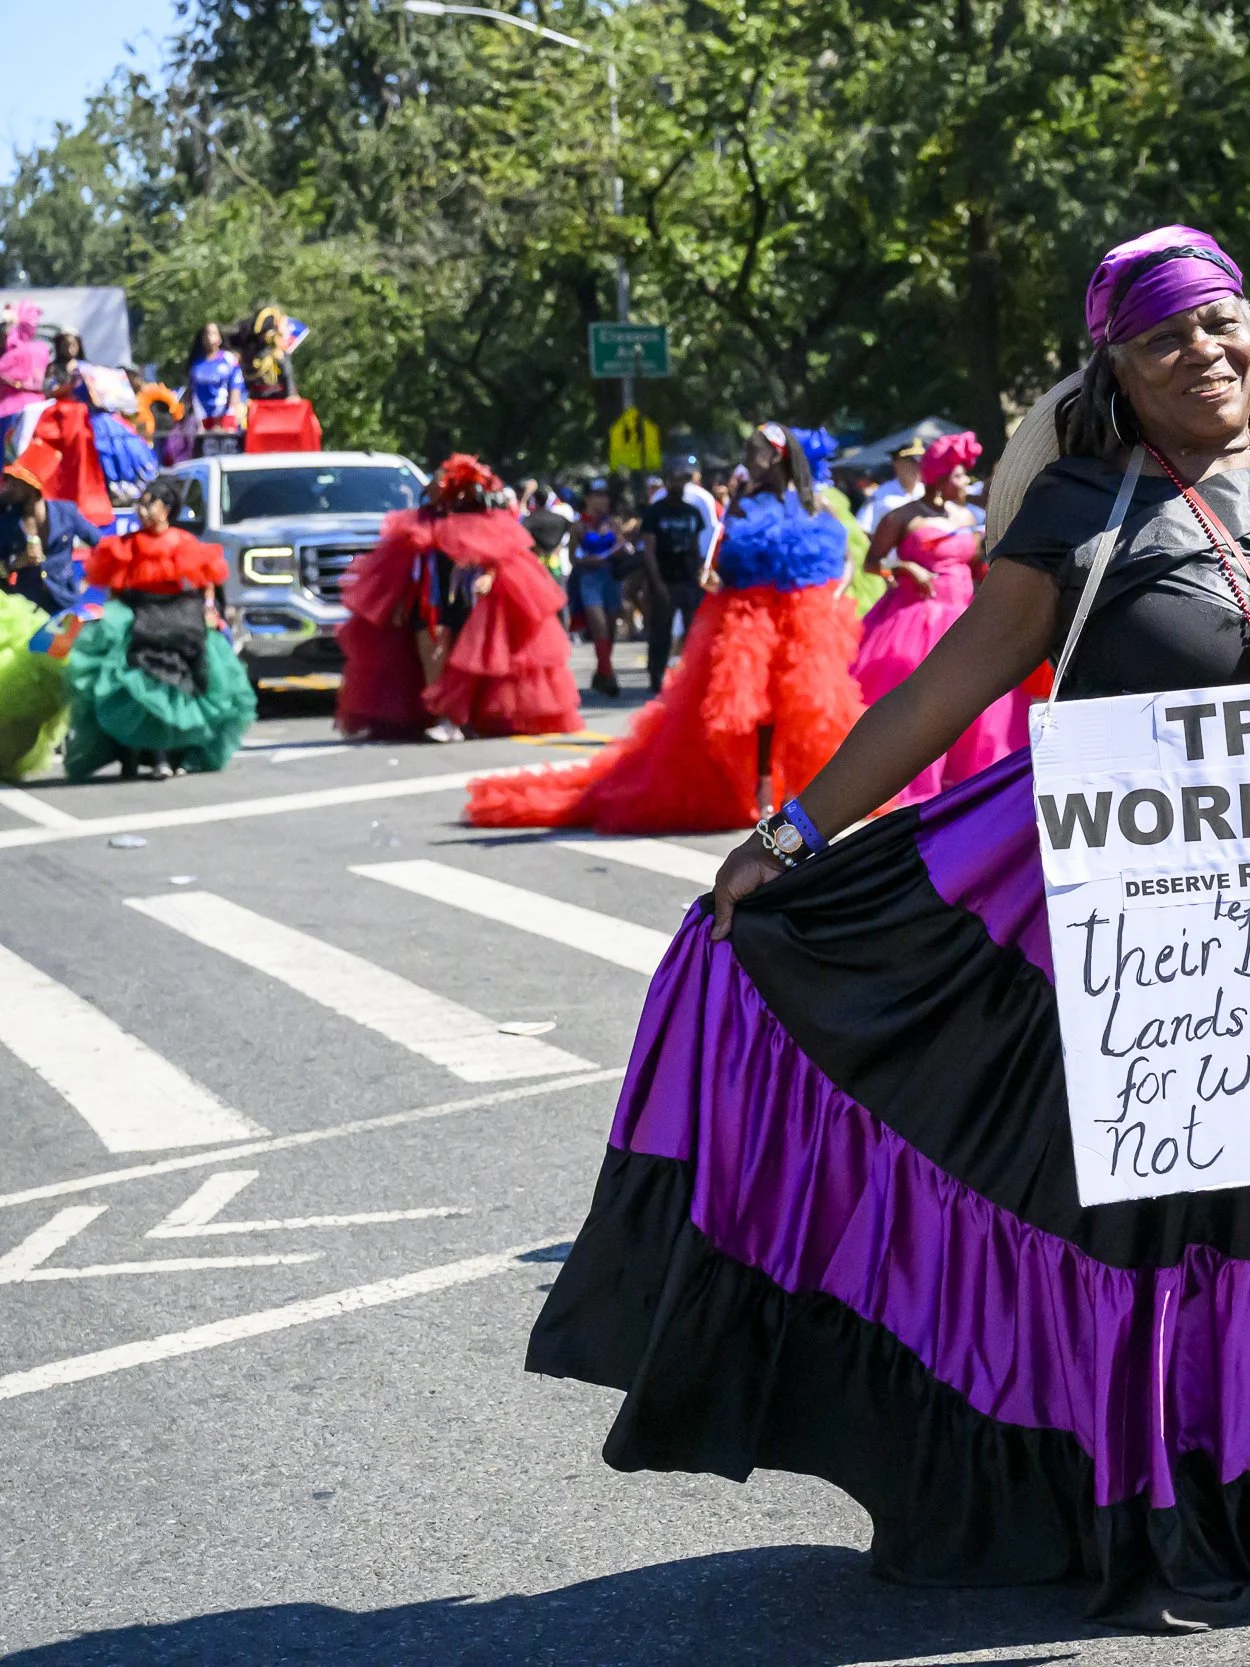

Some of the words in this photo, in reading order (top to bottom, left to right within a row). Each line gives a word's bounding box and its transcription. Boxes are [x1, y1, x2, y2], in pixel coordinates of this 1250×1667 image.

[1125, 873, 1231, 898] DESERVE
[1066, 908, 1222, 997] their
[1094, 1055, 1177, 1124] for
[1106, 1104, 1226, 1178] not
